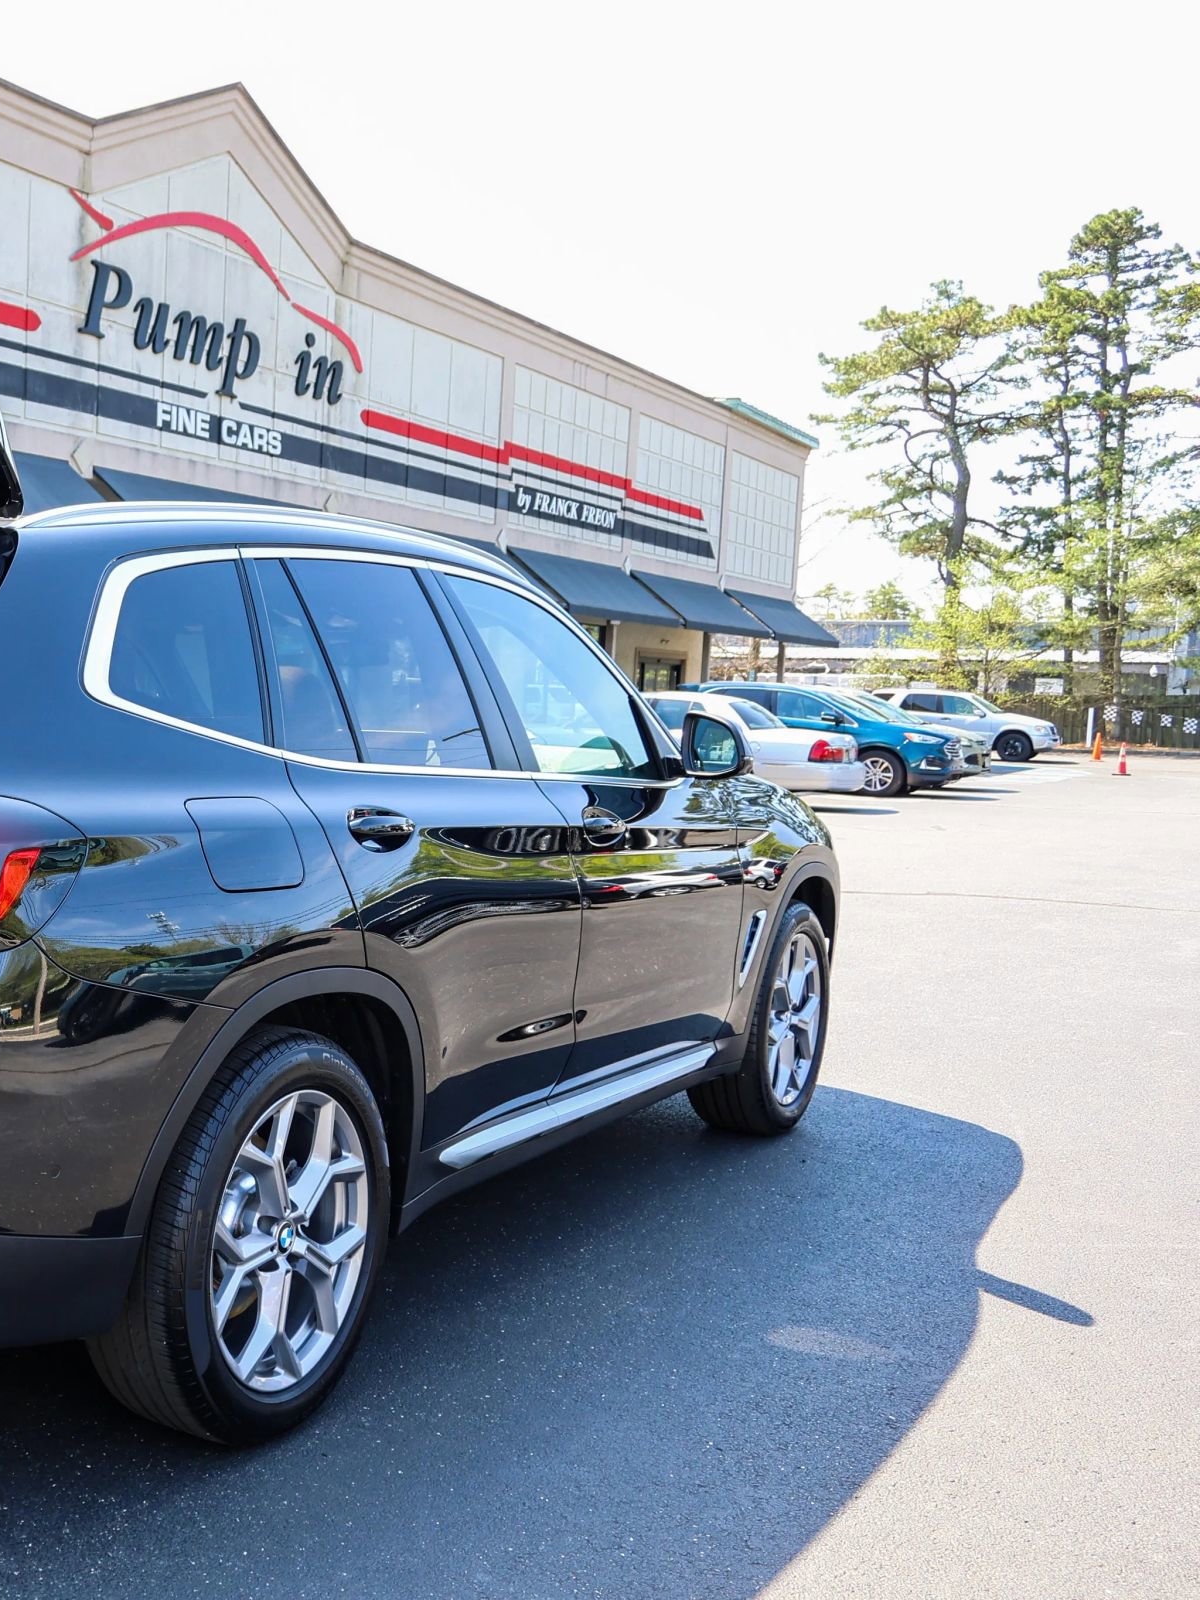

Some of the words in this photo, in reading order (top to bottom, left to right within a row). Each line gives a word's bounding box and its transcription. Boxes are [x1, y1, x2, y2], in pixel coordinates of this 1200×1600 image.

[156, 401, 211, 440] FINE
[221, 419, 282, 455] CARS
[517, 487, 531, 513] by
[533, 492, 579, 519] FRANCK
[581, 504, 617, 529] FREON
